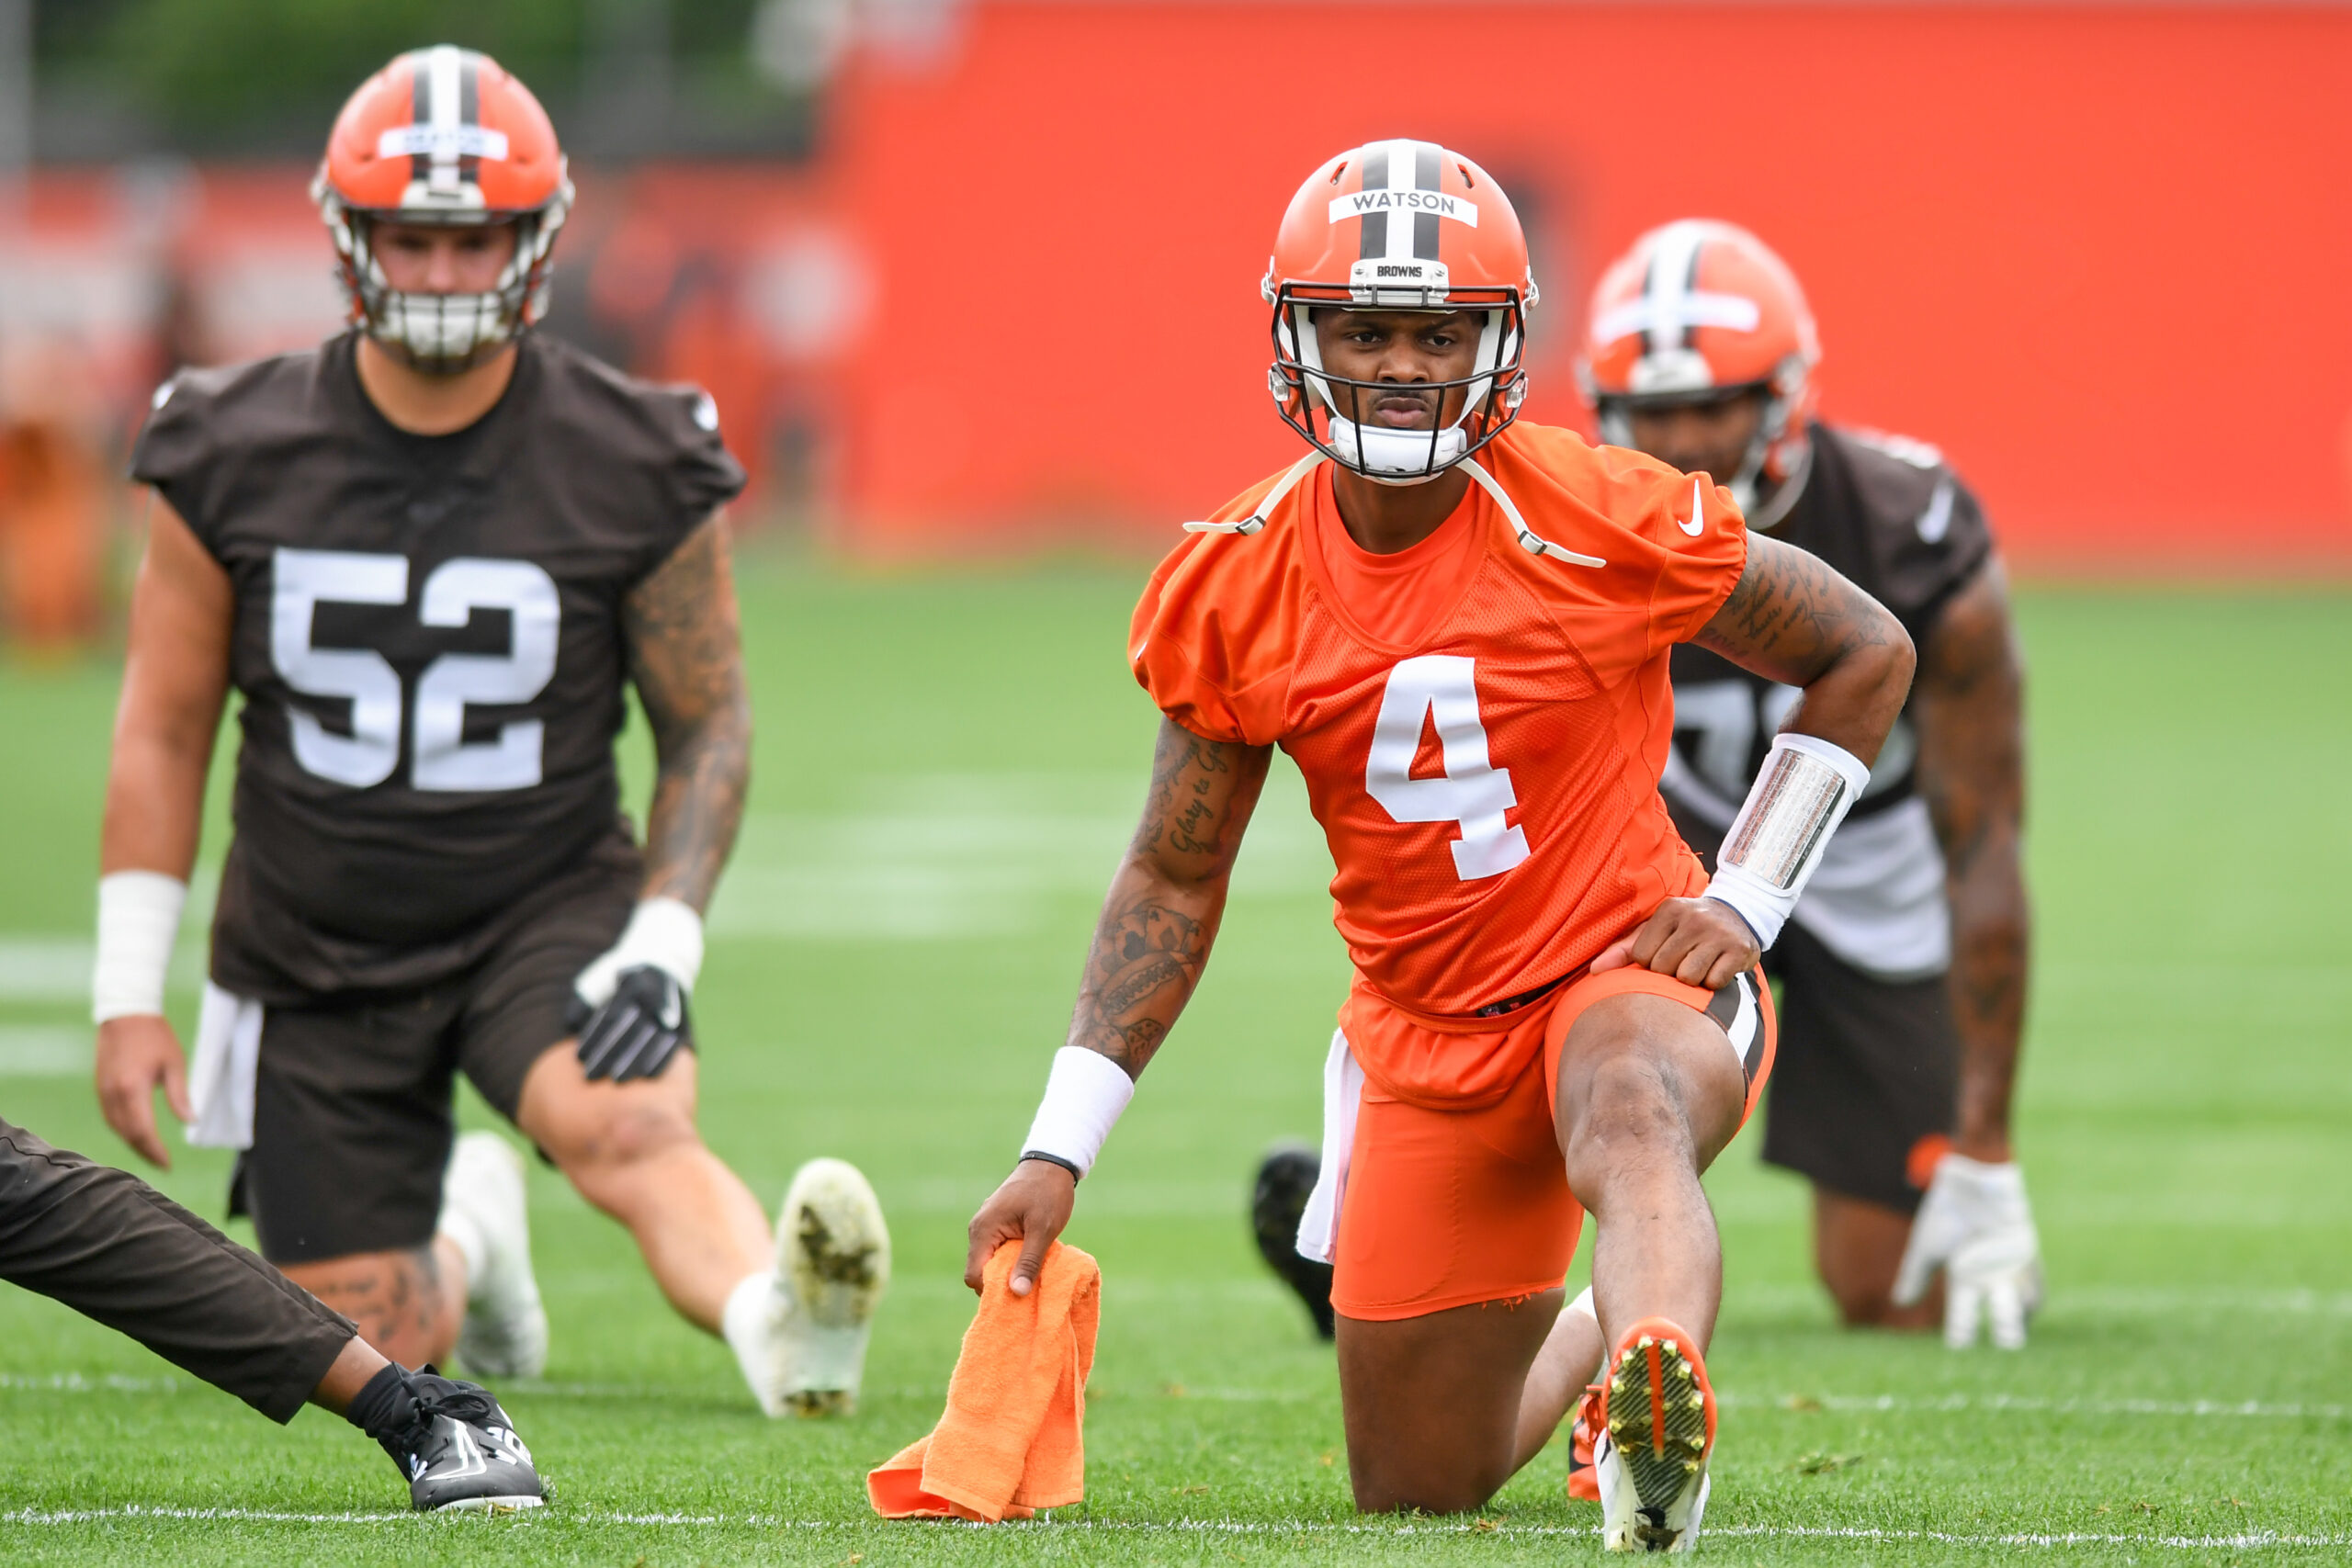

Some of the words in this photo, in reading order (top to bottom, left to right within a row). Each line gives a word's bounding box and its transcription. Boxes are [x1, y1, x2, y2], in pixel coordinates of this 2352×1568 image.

[1353, 192, 1454, 214] WATSON
[1377, 265, 1422, 277] BROWNS
[270, 547, 561, 793] 52
[1365, 654, 1532, 882] 4
